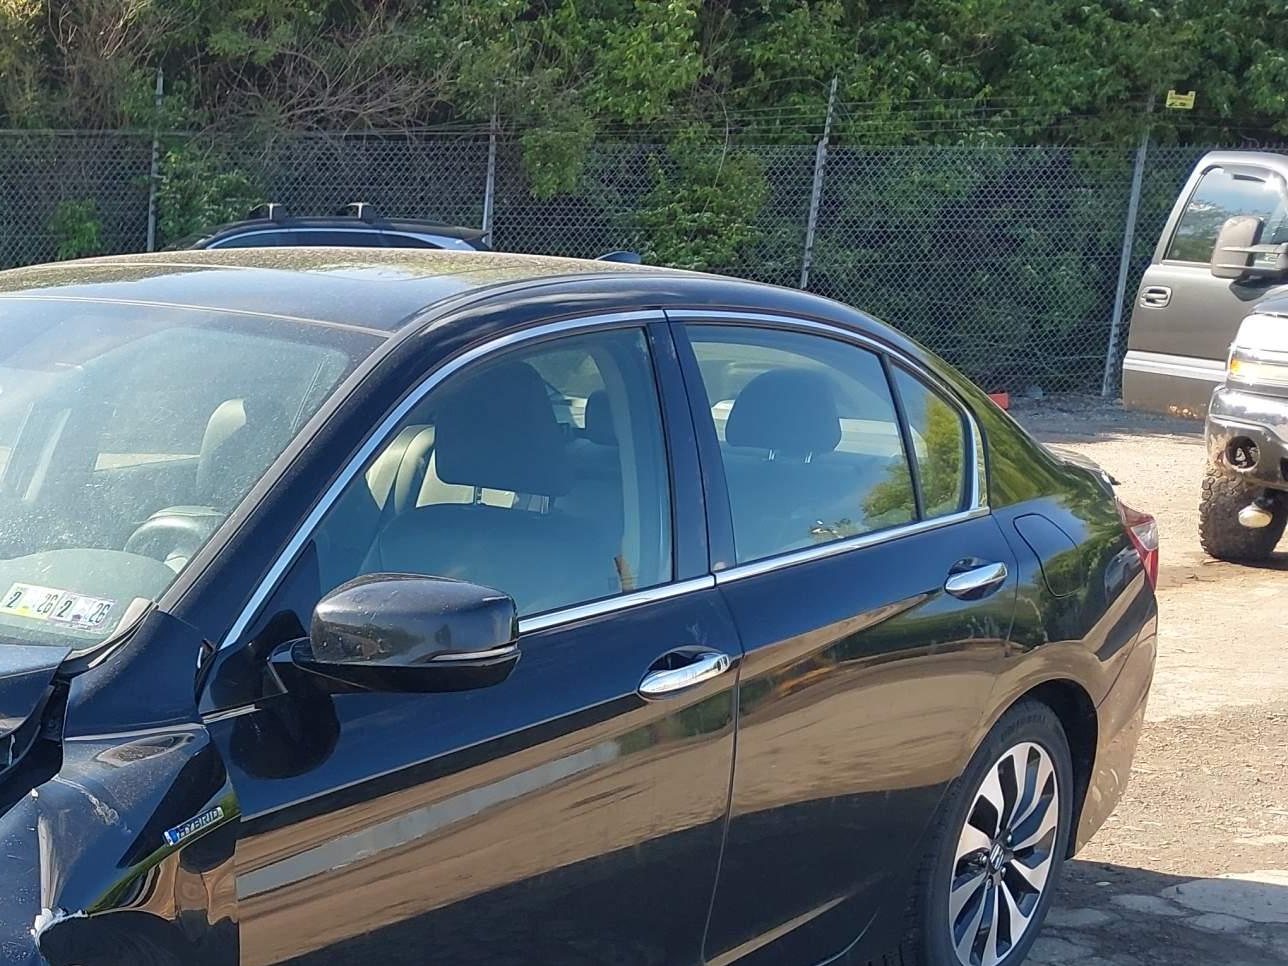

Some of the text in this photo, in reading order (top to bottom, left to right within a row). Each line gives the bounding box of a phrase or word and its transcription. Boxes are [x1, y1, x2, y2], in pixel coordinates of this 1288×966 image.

[6, 591, 22, 609] 2
[57, 600, 73, 618] 2
[176, 808, 220, 838] HYBRID
